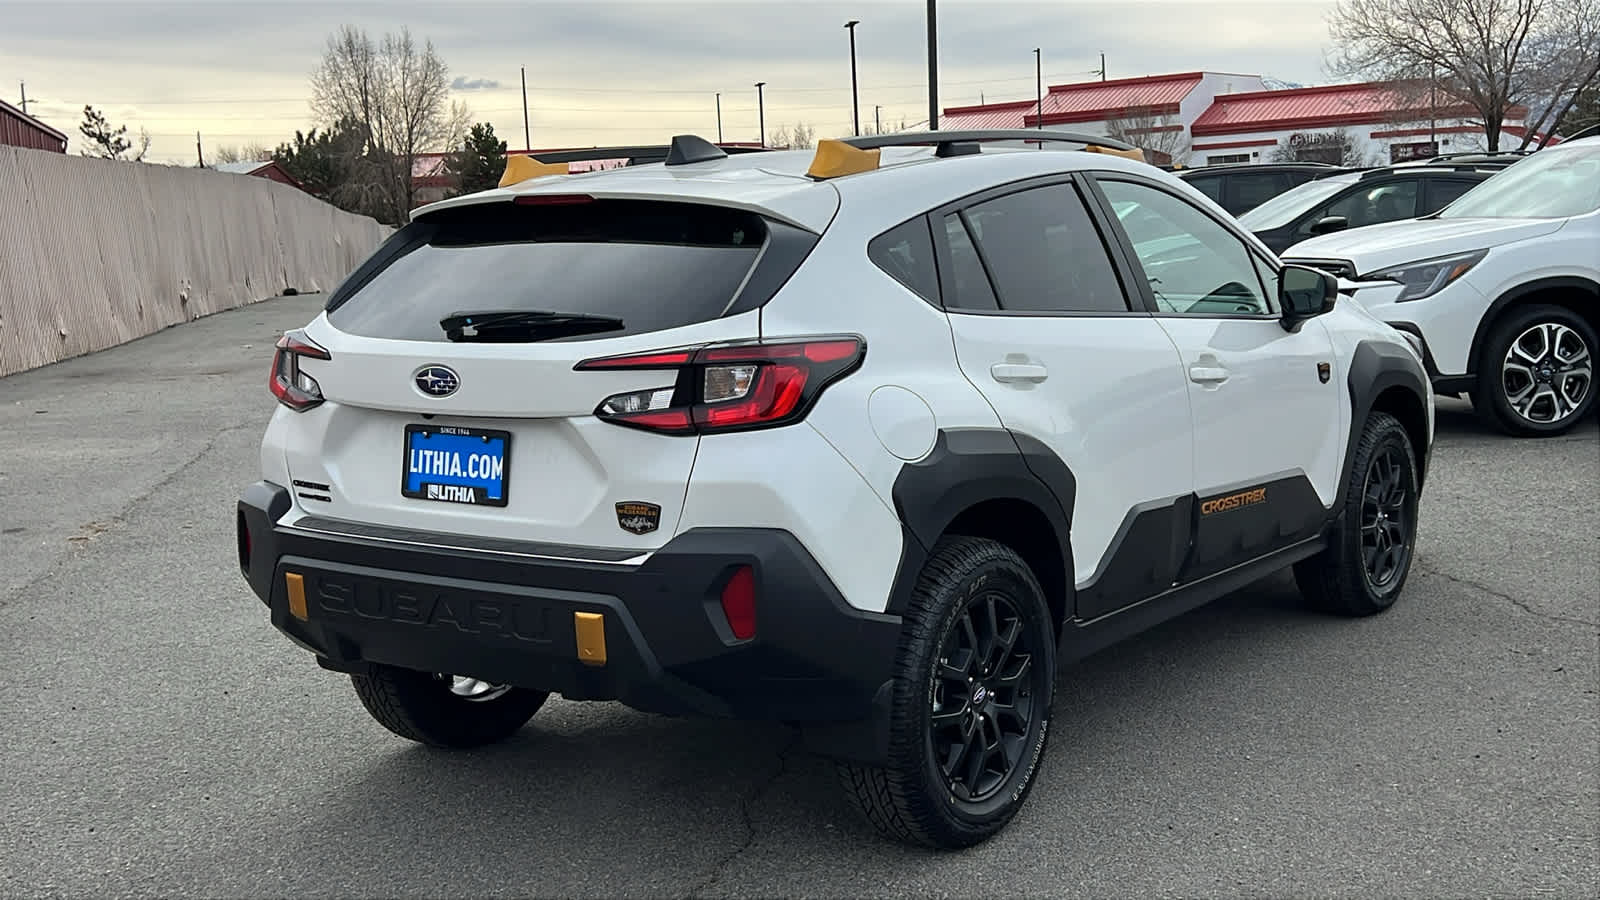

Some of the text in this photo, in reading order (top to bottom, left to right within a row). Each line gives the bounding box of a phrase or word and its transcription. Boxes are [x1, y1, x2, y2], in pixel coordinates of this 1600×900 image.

[440, 427, 456, 435] SINCE
[410, 449, 504, 480] LITHIA.COM
[439, 484, 475, 503] LITHIA
[1201, 487, 1266, 514] CROSSTREK
[318, 576, 553, 643] SUBARU
